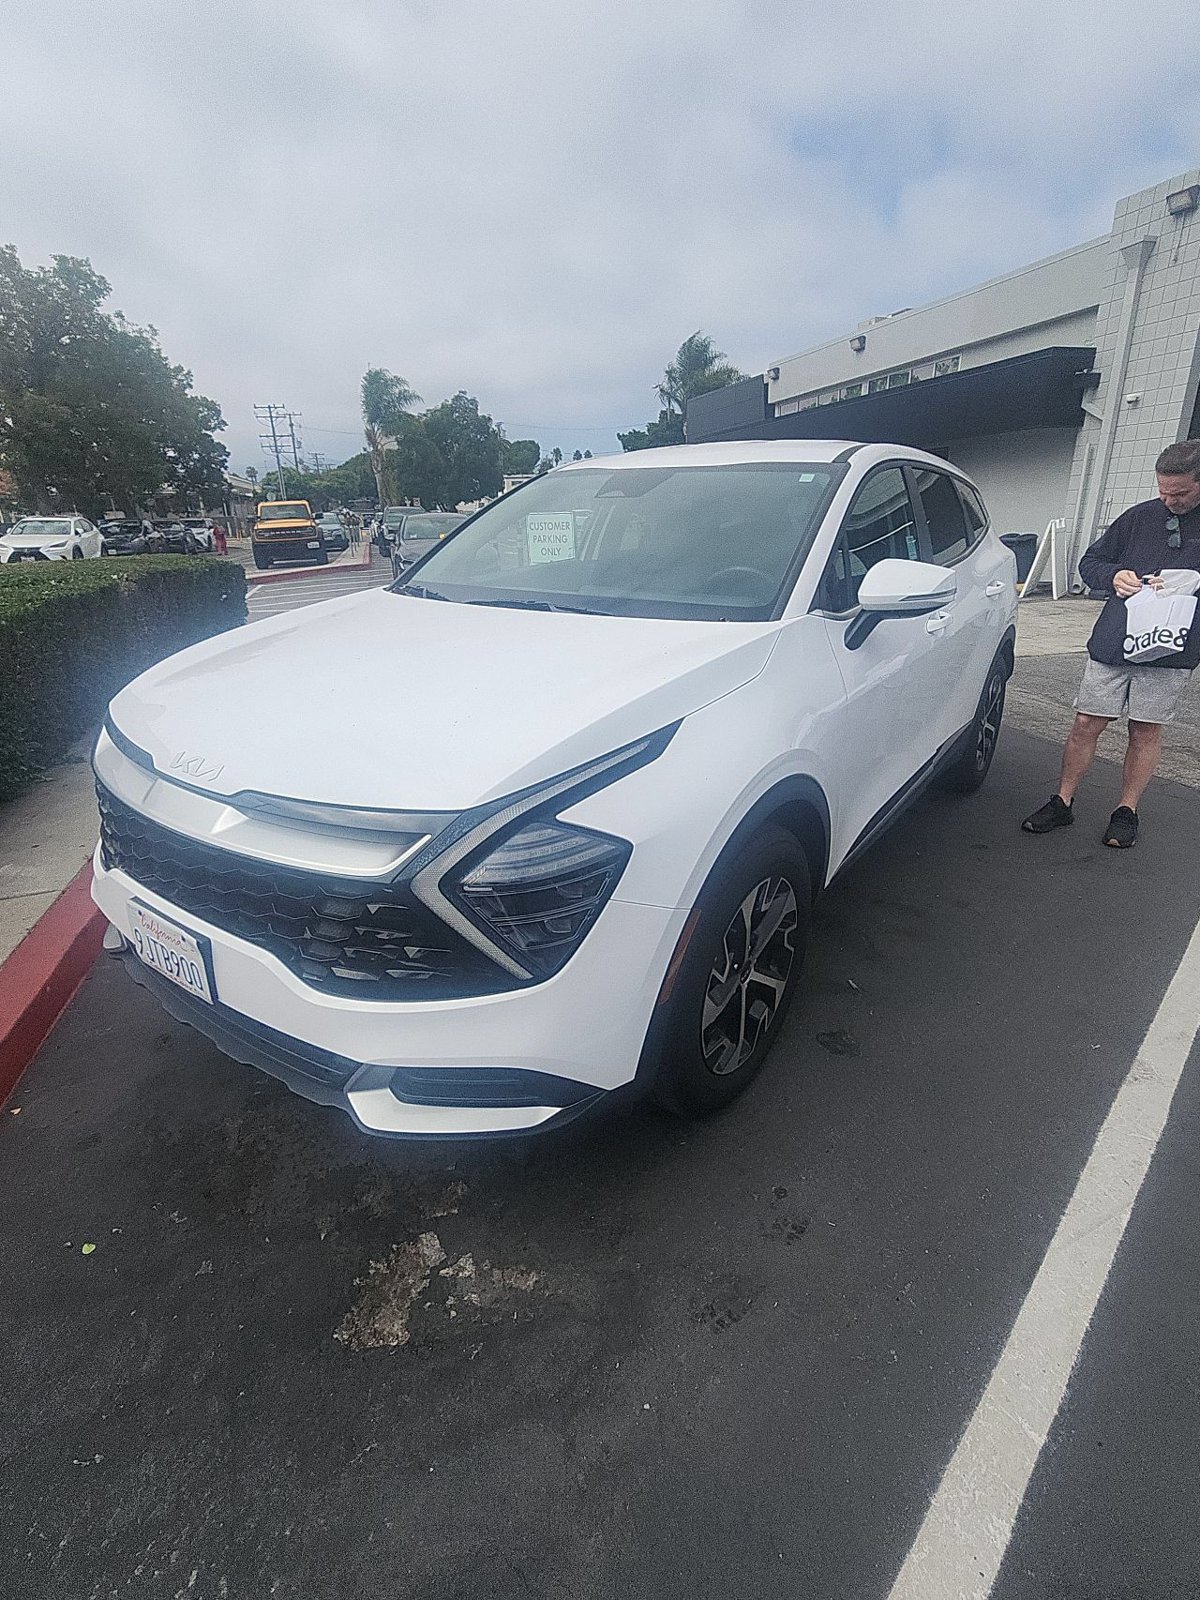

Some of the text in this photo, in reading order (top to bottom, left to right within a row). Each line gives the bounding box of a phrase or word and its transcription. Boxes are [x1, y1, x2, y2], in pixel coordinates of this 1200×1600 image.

[530, 521, 570, 531] CUSTOMER
[533, 534, 568, 544] PARKING
[541, 547, 561, 556] ONLY
[1123, 626, 1188, 655] Crate&
[134, 928, 204, 992] 9JTB900
